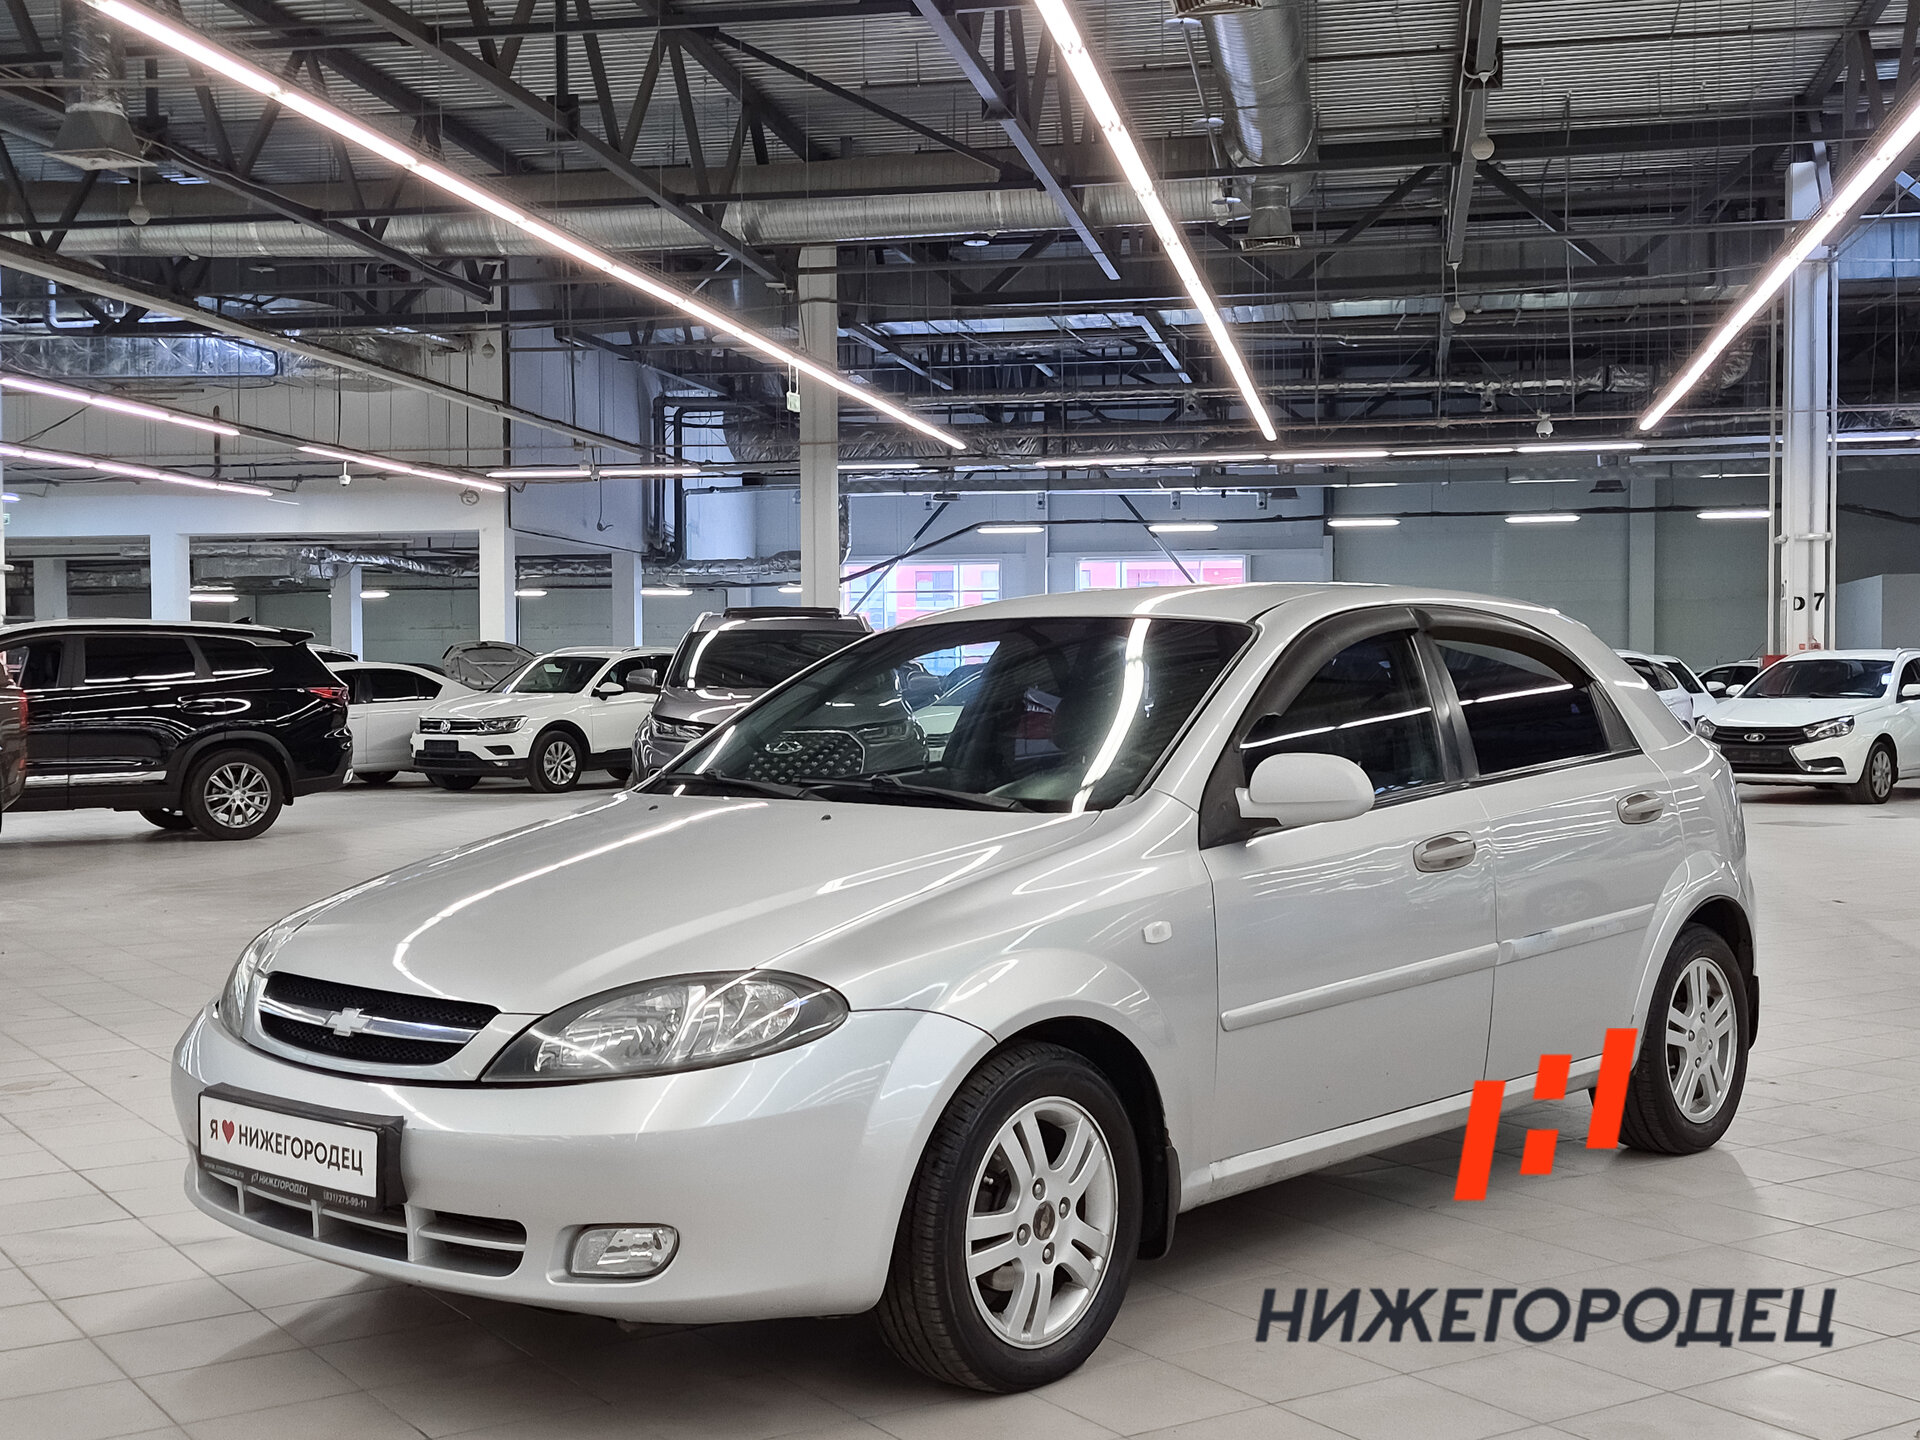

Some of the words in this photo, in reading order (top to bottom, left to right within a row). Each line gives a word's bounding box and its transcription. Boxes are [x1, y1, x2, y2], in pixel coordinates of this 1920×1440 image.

[1793, 596, 1806, 611] D
[1813, 592, 1825, 611] 7
[209, 1119, 219, 1141] Я
[238, 1124, 364, 1176] НИЖЕГОРОДЕЦ
[259, 1174, 309, 1196] НИЖЕГОРОДЕЦ
